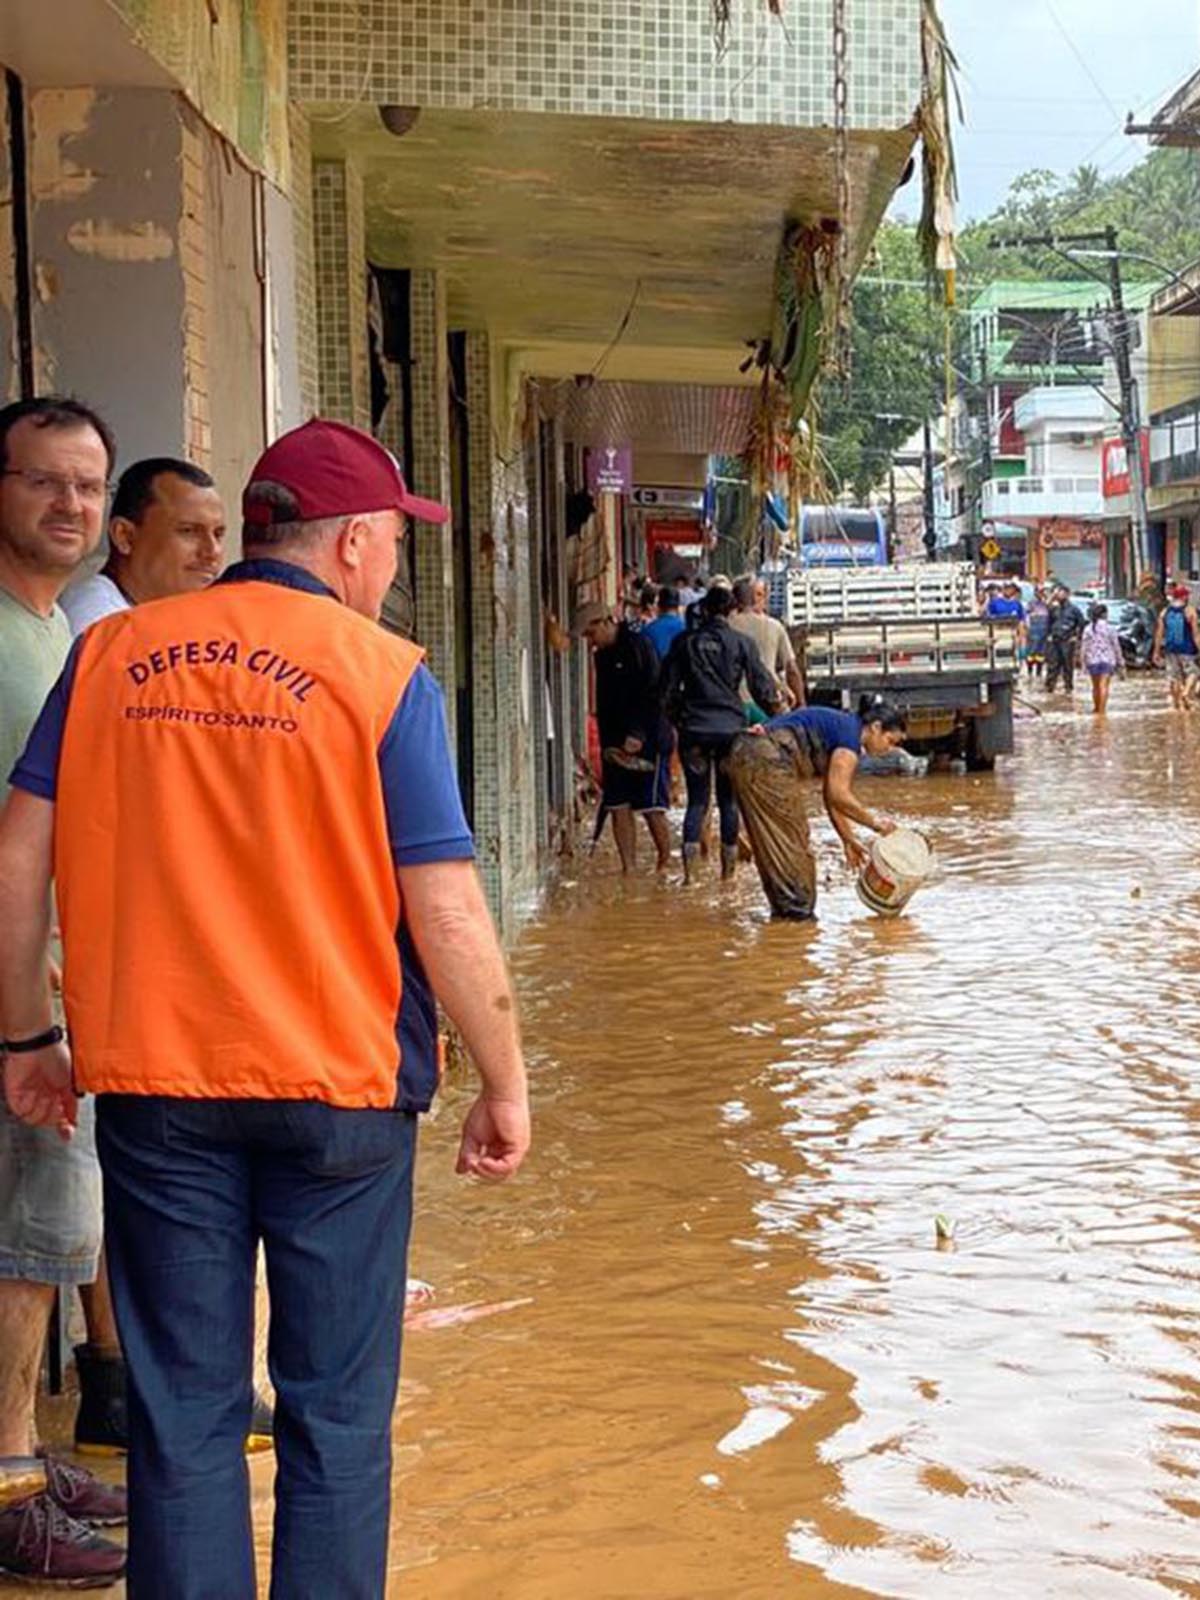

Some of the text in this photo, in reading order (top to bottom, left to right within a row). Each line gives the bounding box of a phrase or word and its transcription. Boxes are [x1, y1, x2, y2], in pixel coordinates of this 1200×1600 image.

[127, 641, 316, 703] DEFESA CIVIL
[221, 710, 299, 733] SANTO
